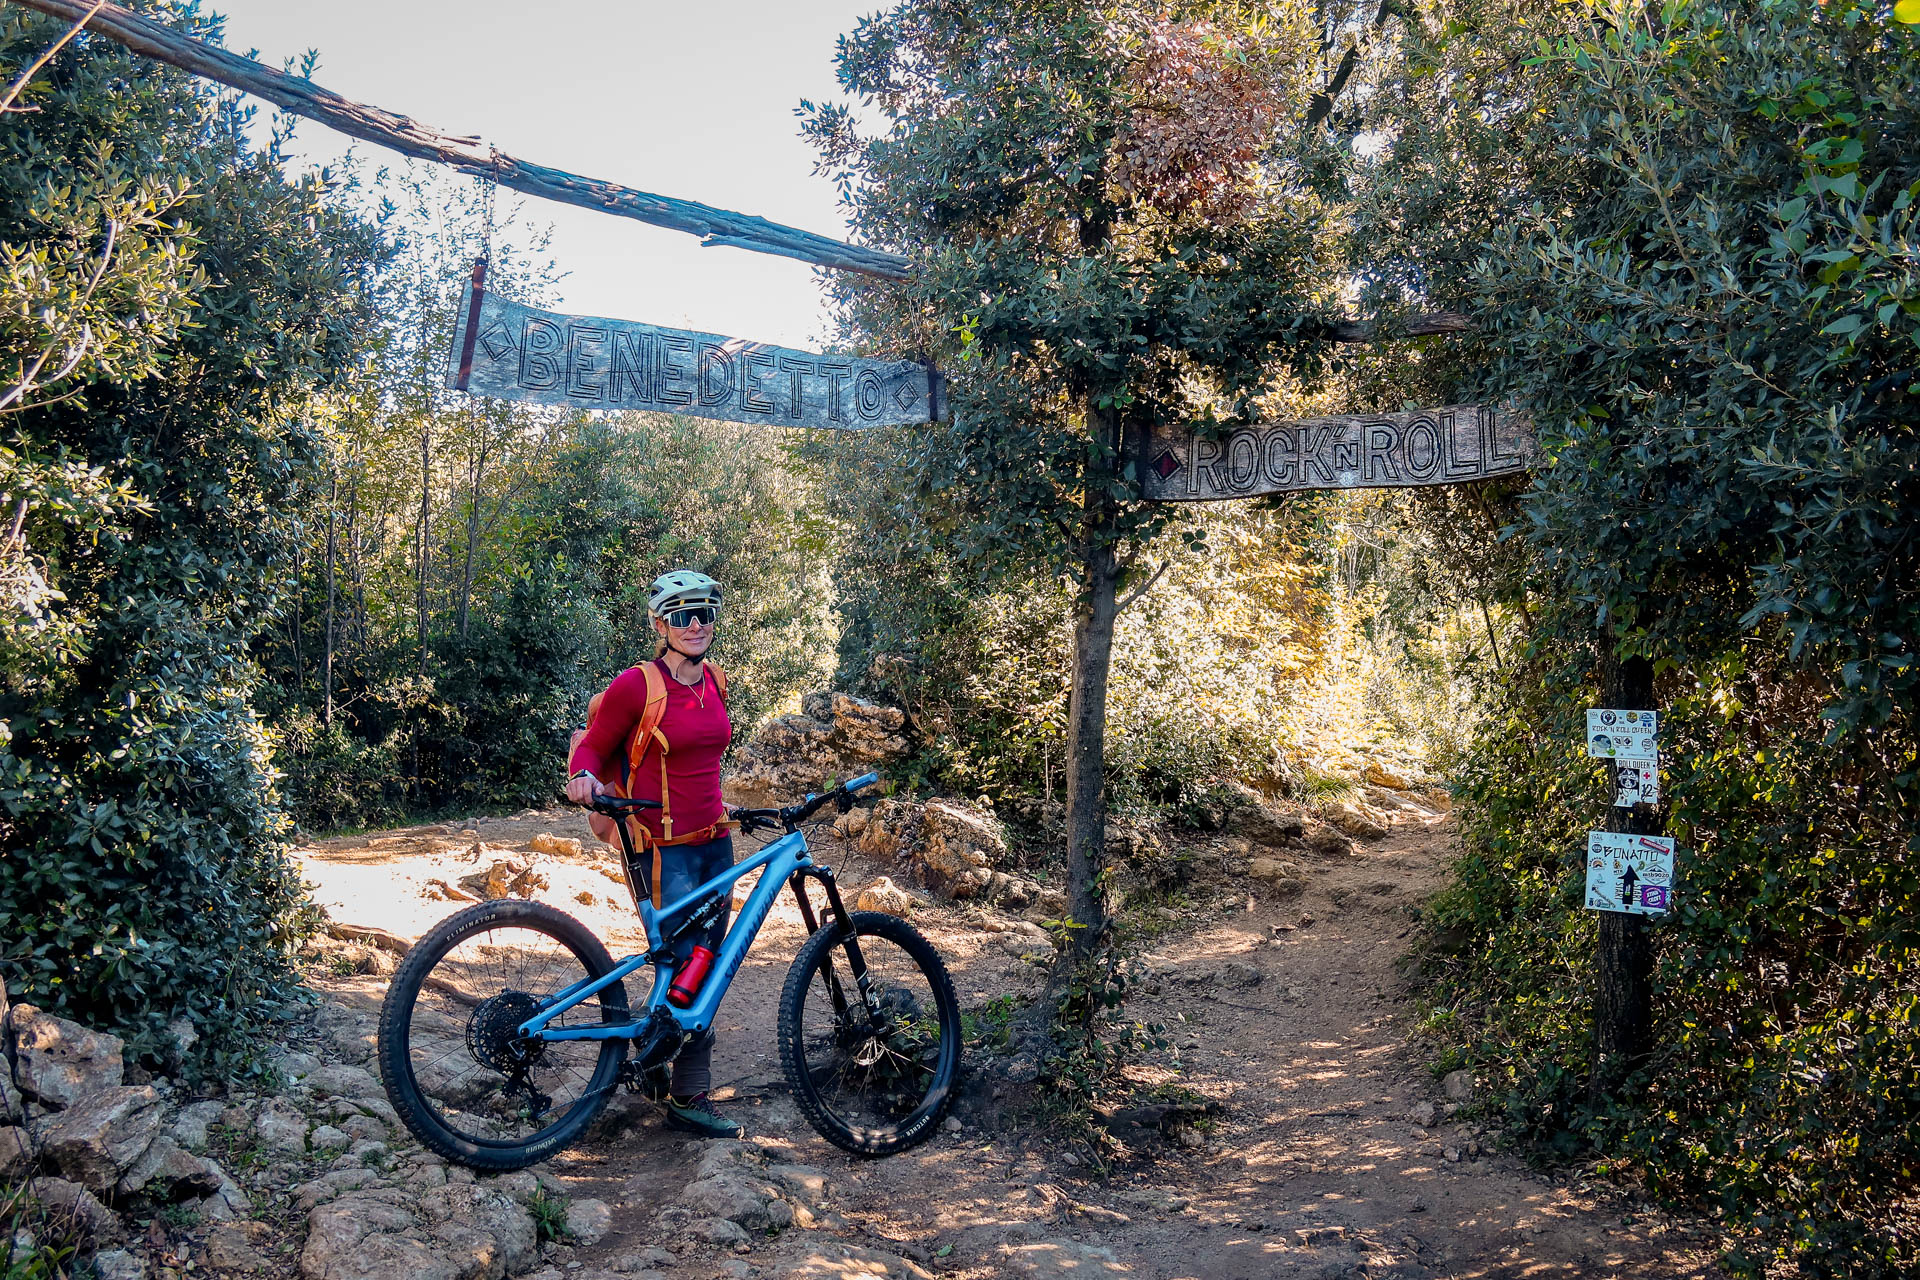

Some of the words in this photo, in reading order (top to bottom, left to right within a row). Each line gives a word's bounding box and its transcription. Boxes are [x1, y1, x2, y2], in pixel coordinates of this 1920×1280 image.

[517, 315, 887, 422] BENEDETTO
[1187, 424, 1340, 494] ROCK
[1361, 406, 1525, 482] ROLL
[1632, 727, 1652, 735] QUEEN
[1618, 759, 1632, 768] ROLL
[1633, 760, 1651, 769] QUEEN
[1603, 846, 1659, 862] BONATTO
[1614, 882, 1624, 900] START
[446, 913, 496, 942] ELIMINATOR
[905, 1115, 931, 1137] BUTCHER
